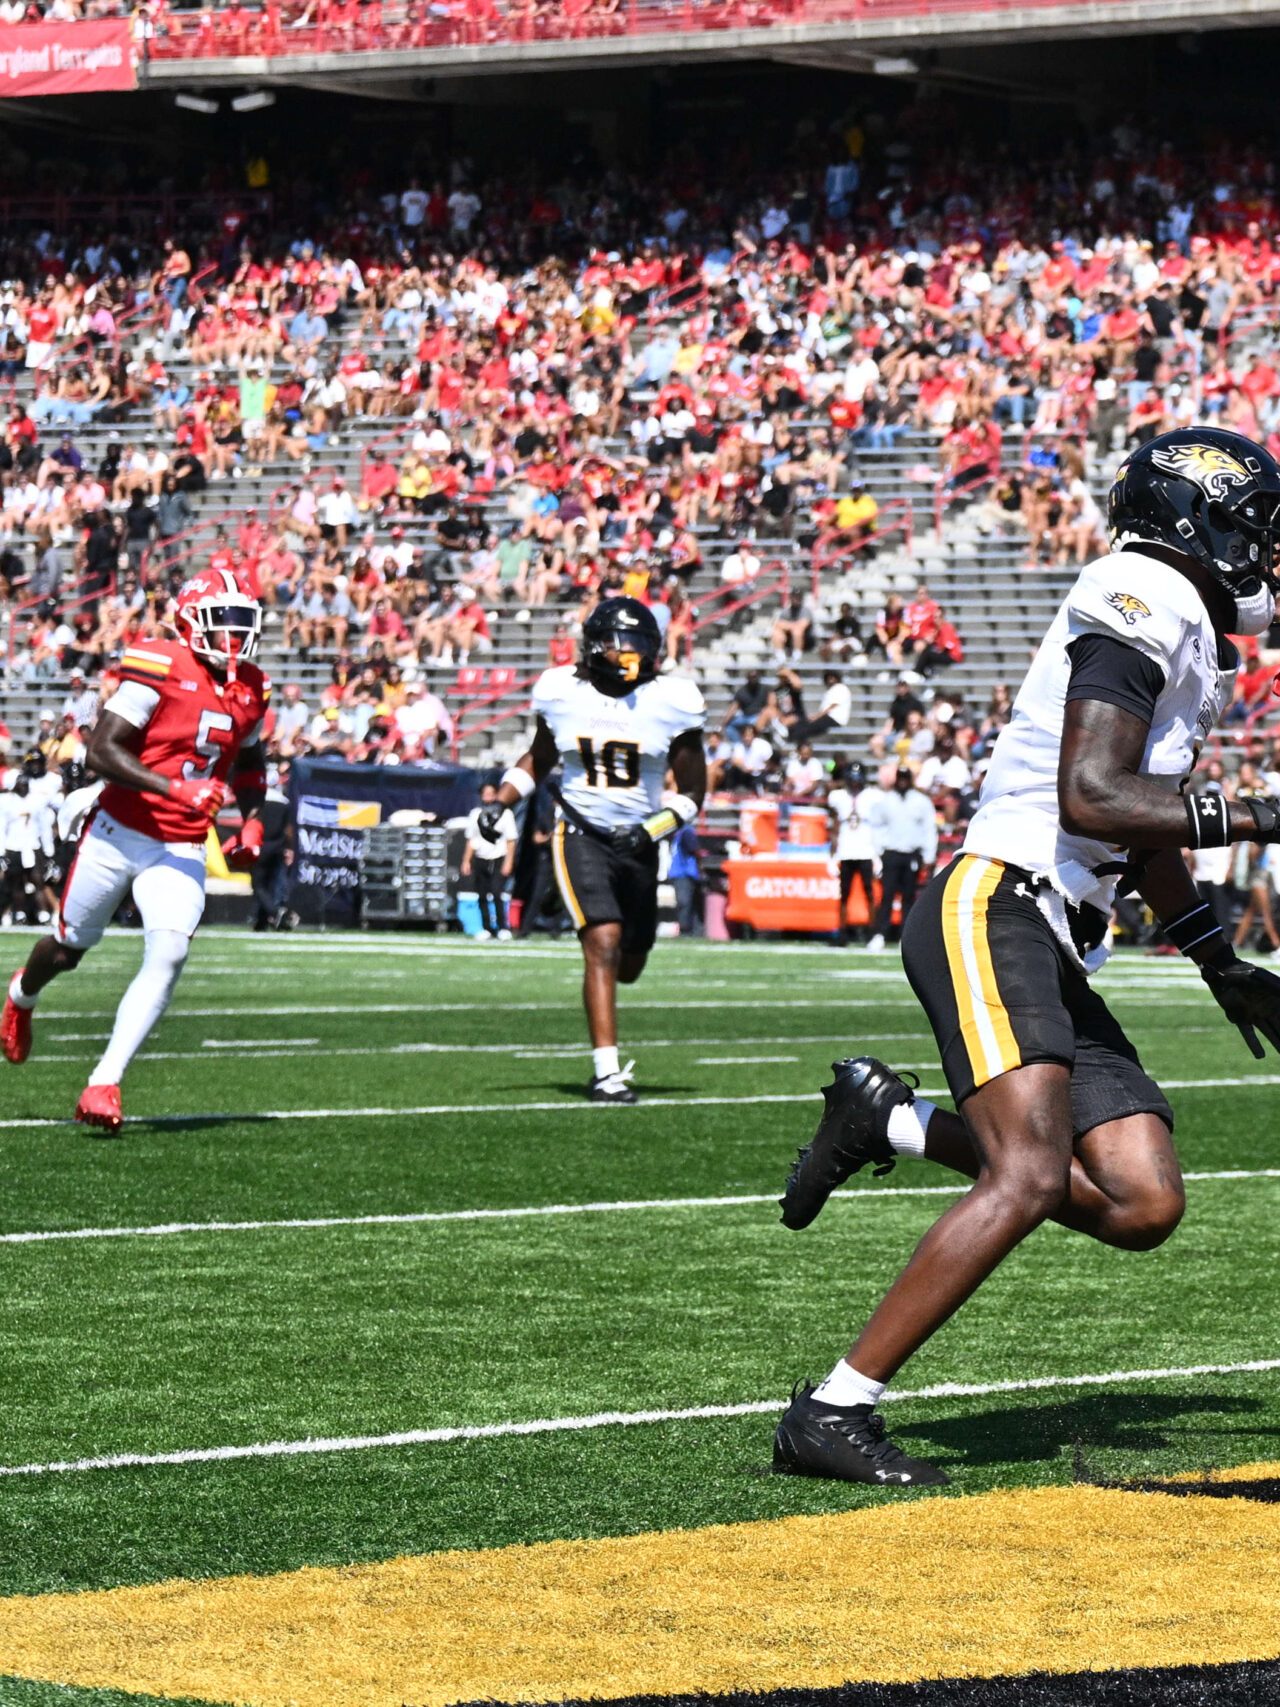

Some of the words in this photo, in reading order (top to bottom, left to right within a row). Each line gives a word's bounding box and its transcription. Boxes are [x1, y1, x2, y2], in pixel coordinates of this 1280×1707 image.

[182, 709, 233, 782] 5
[576, 736, 641, 789] 10
[745, 876, 842, 900] GATORADE
